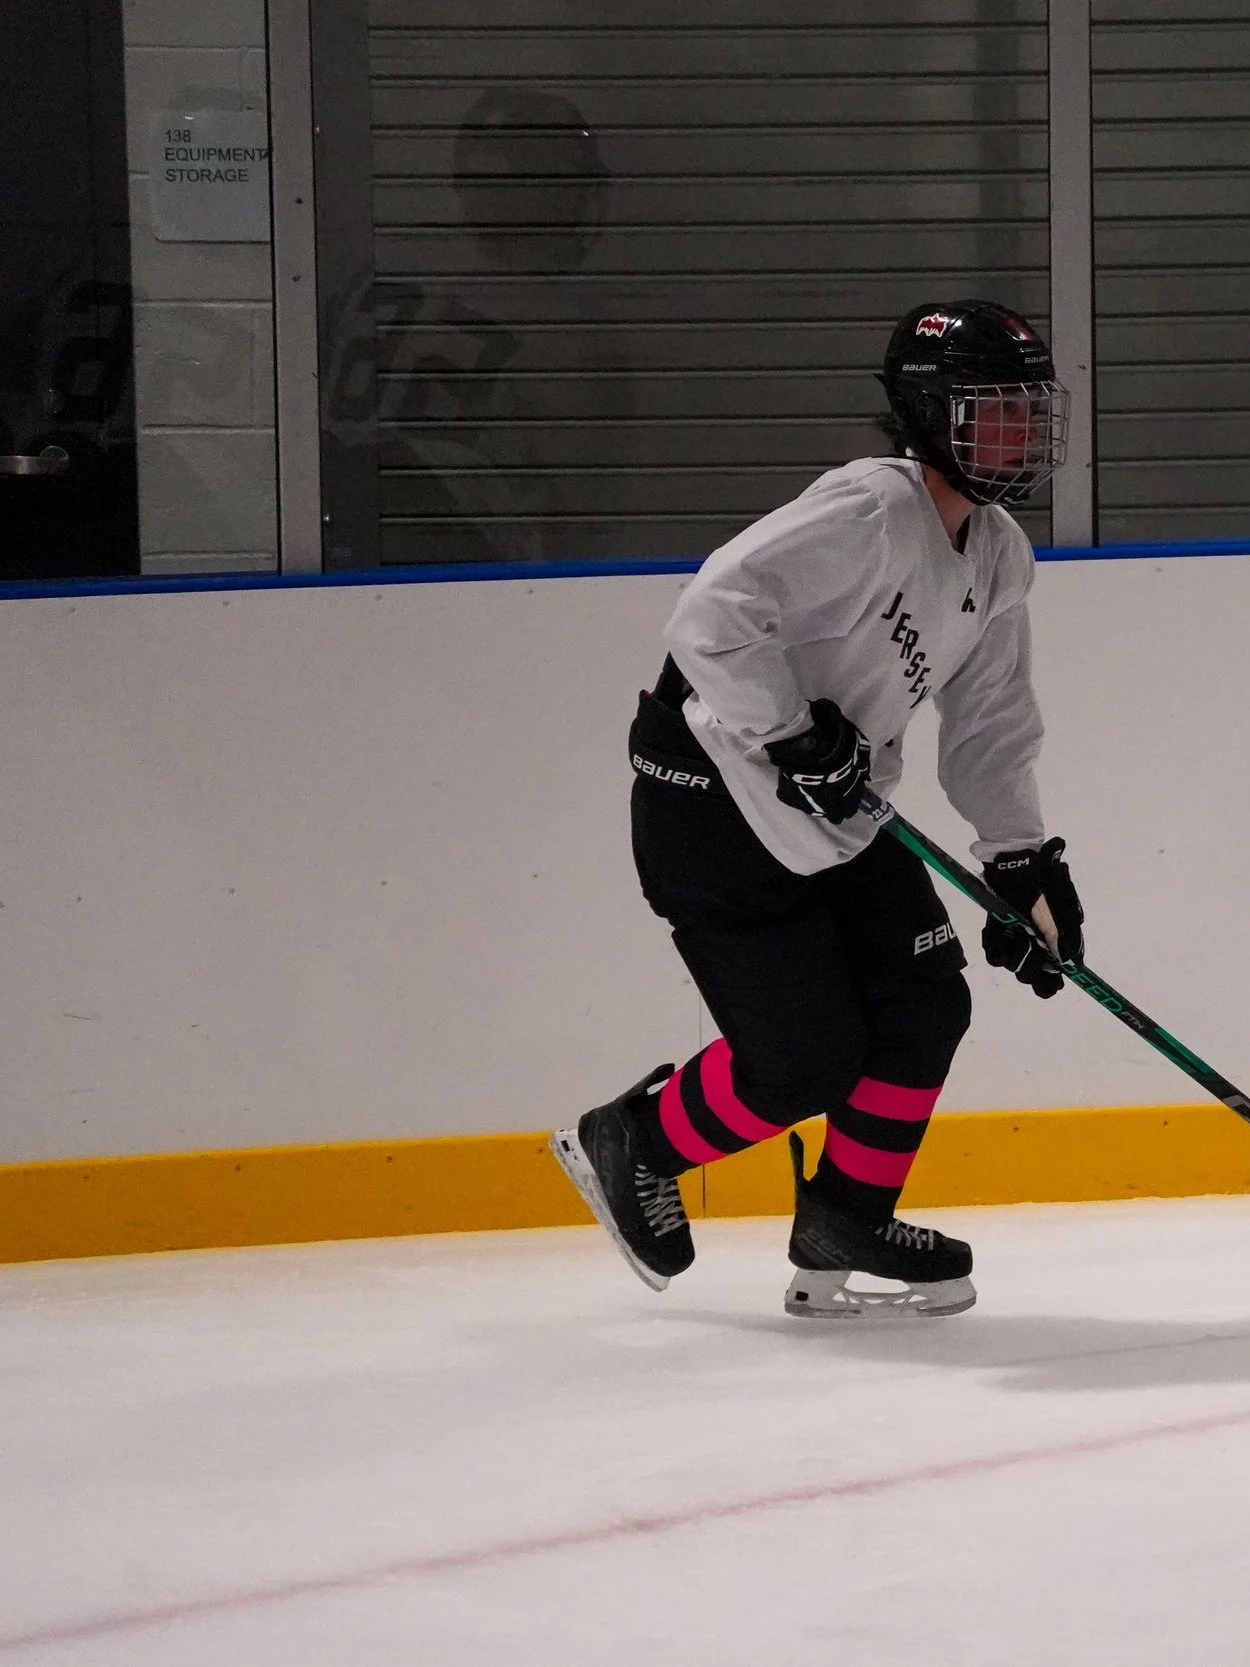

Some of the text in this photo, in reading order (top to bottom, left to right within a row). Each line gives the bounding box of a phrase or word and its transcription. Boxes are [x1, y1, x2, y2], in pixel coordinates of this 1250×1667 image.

[165, 129, 192, 142] 138
[164, 147, 268, 161] EQUIPMENT
[165, 168, 249, 182] STORAGE
[902, 363, 937, 372] BAUER
[632, 754, 711, 790] BAUER
[997, 857, 1031, 871] CCM
